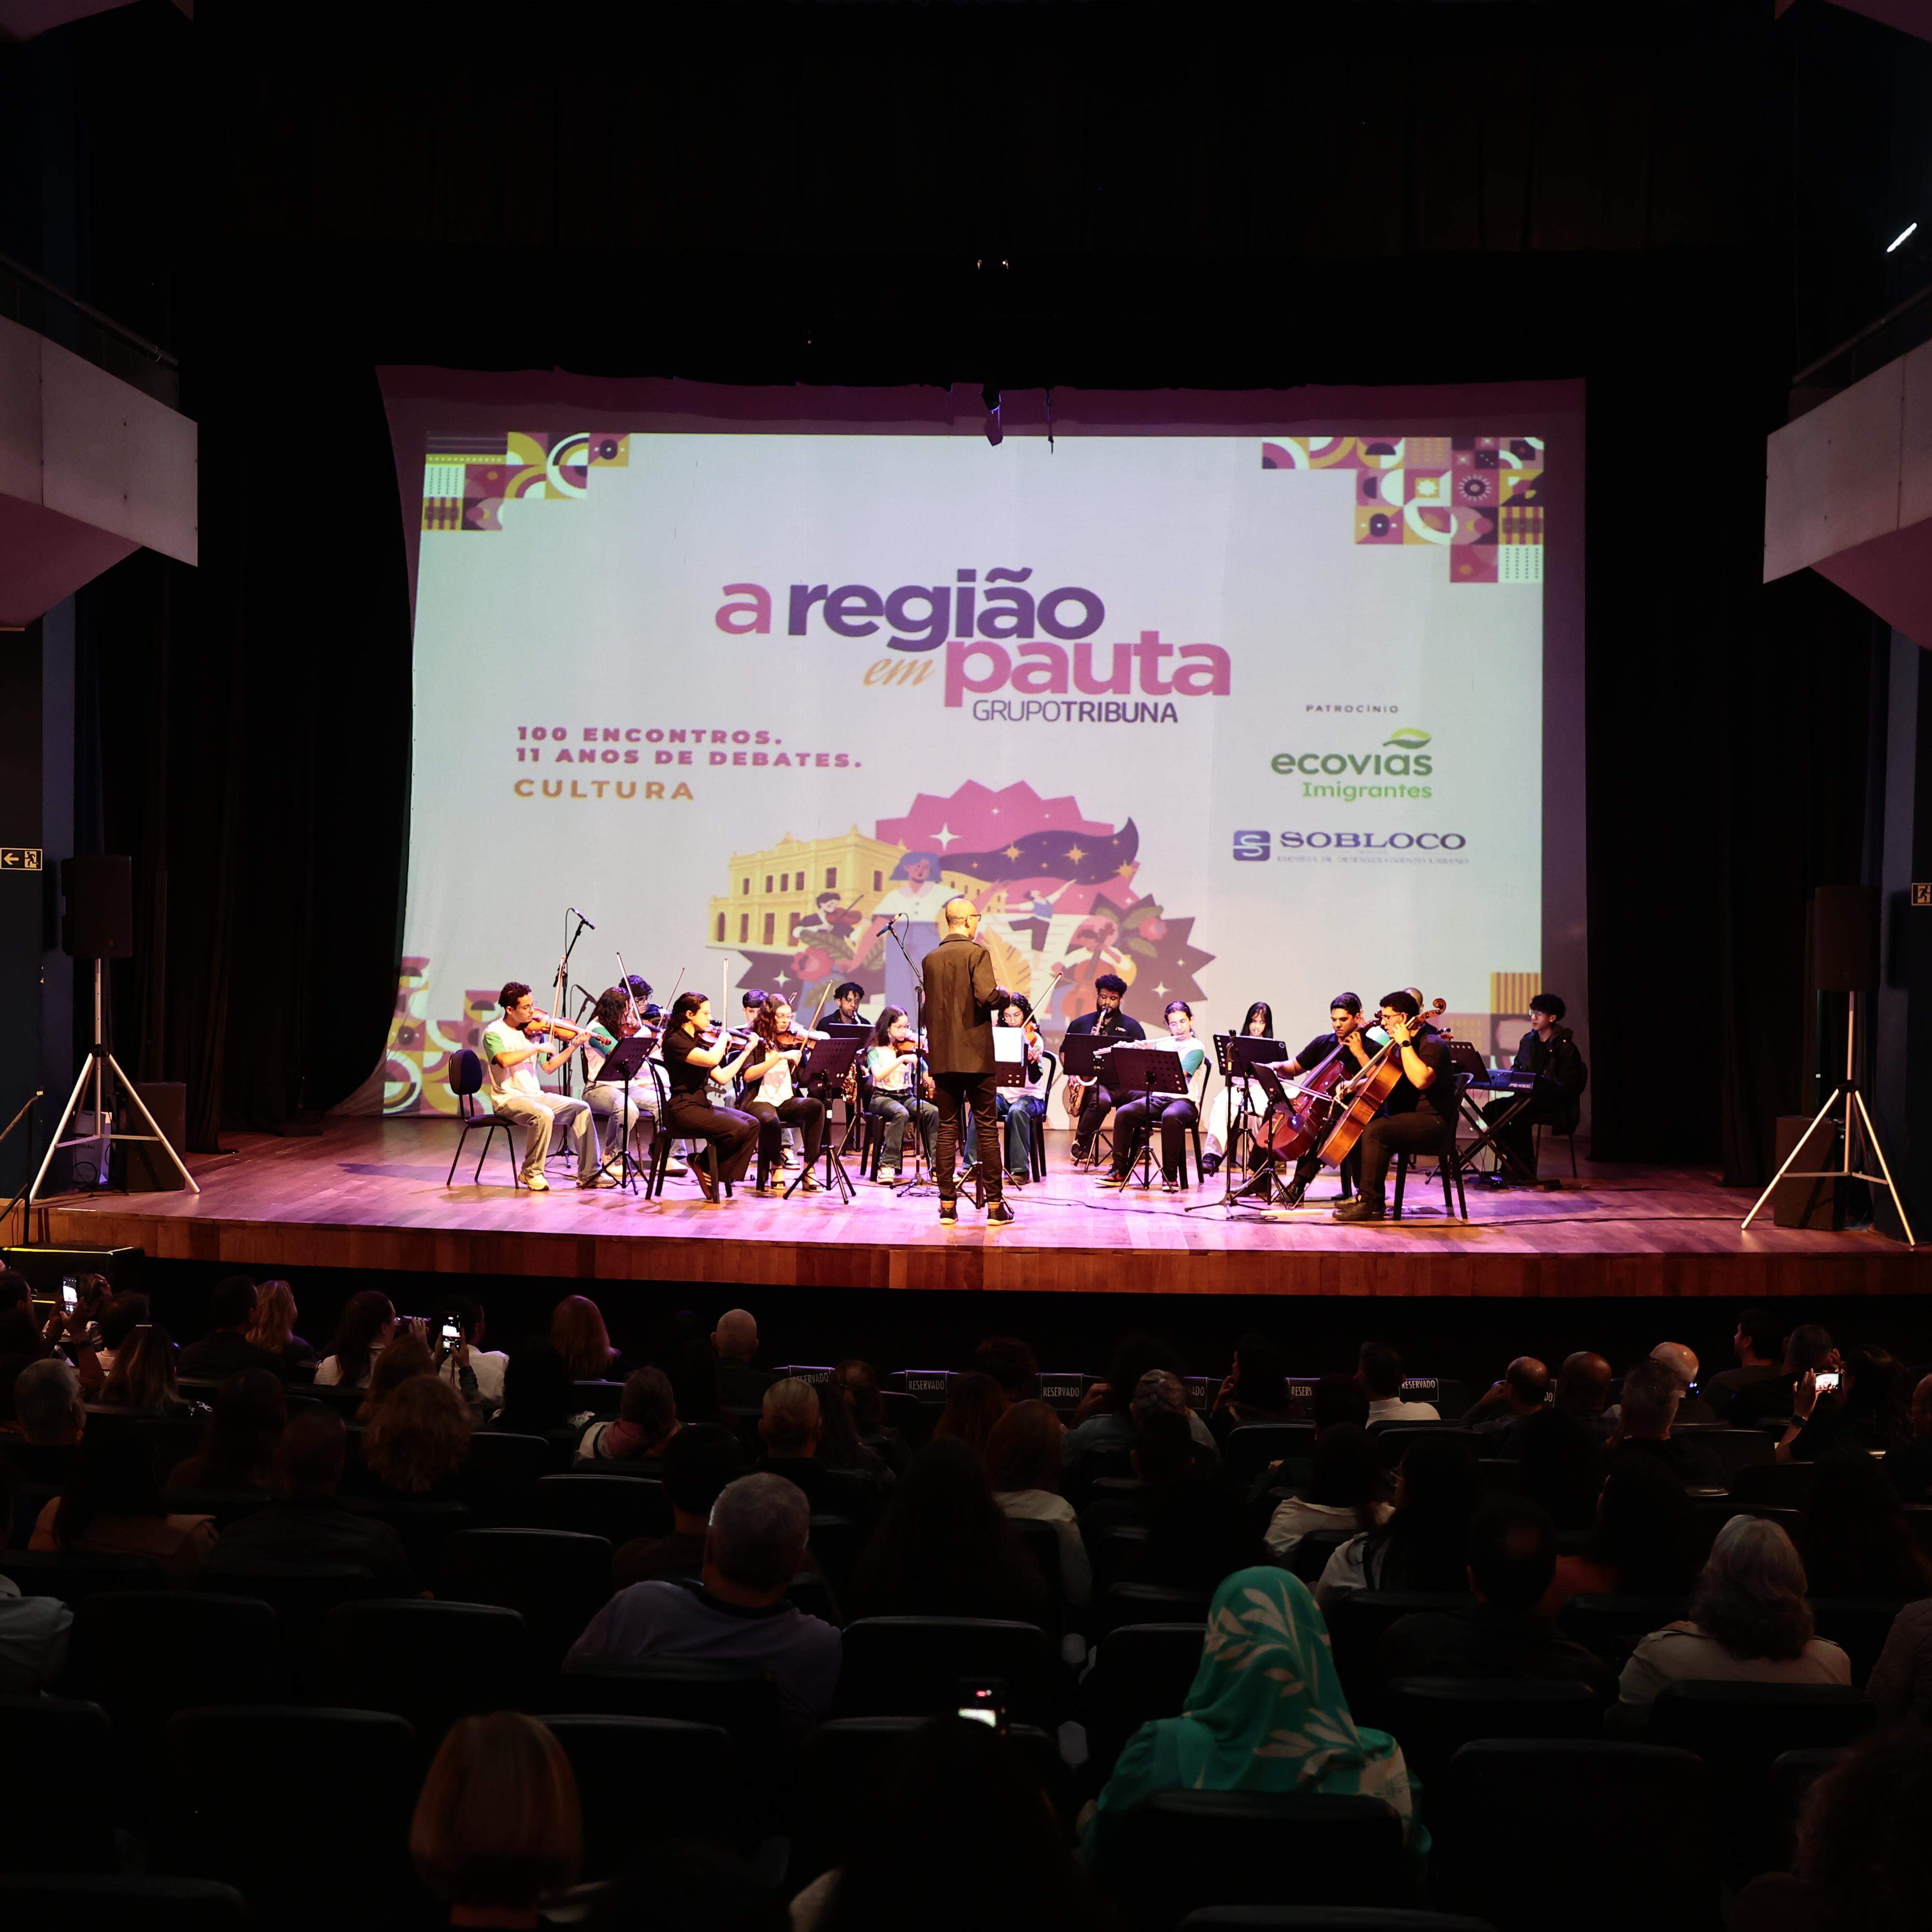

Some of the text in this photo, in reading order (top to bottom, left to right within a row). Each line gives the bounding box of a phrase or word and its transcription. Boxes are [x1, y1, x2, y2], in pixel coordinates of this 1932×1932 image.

[714, 567, 1105, 652] a região
[862, 630, 1231, 708] em pauta
[973, 699, 1179, 724] GRUPOTRIBUNA
[517, 726, 782, 745] 100 ENCONTROS.
[516, 747, 862, 768] 11 ANOS DE DEBATES.
[1271, 753, 1433, 777] ecovias
[513, 779, 695, 800] CULTURA
[1302, 781, 1433, 802] Imigrantes
[1280, 831, 1466, 851] SOBLOCO
[908, 1379, 945, 1391] RESERVADO
[1043, 1387, 1080, 1397] RESERVADO
[1401, 1379, 1436, 1390] RESERVADO
